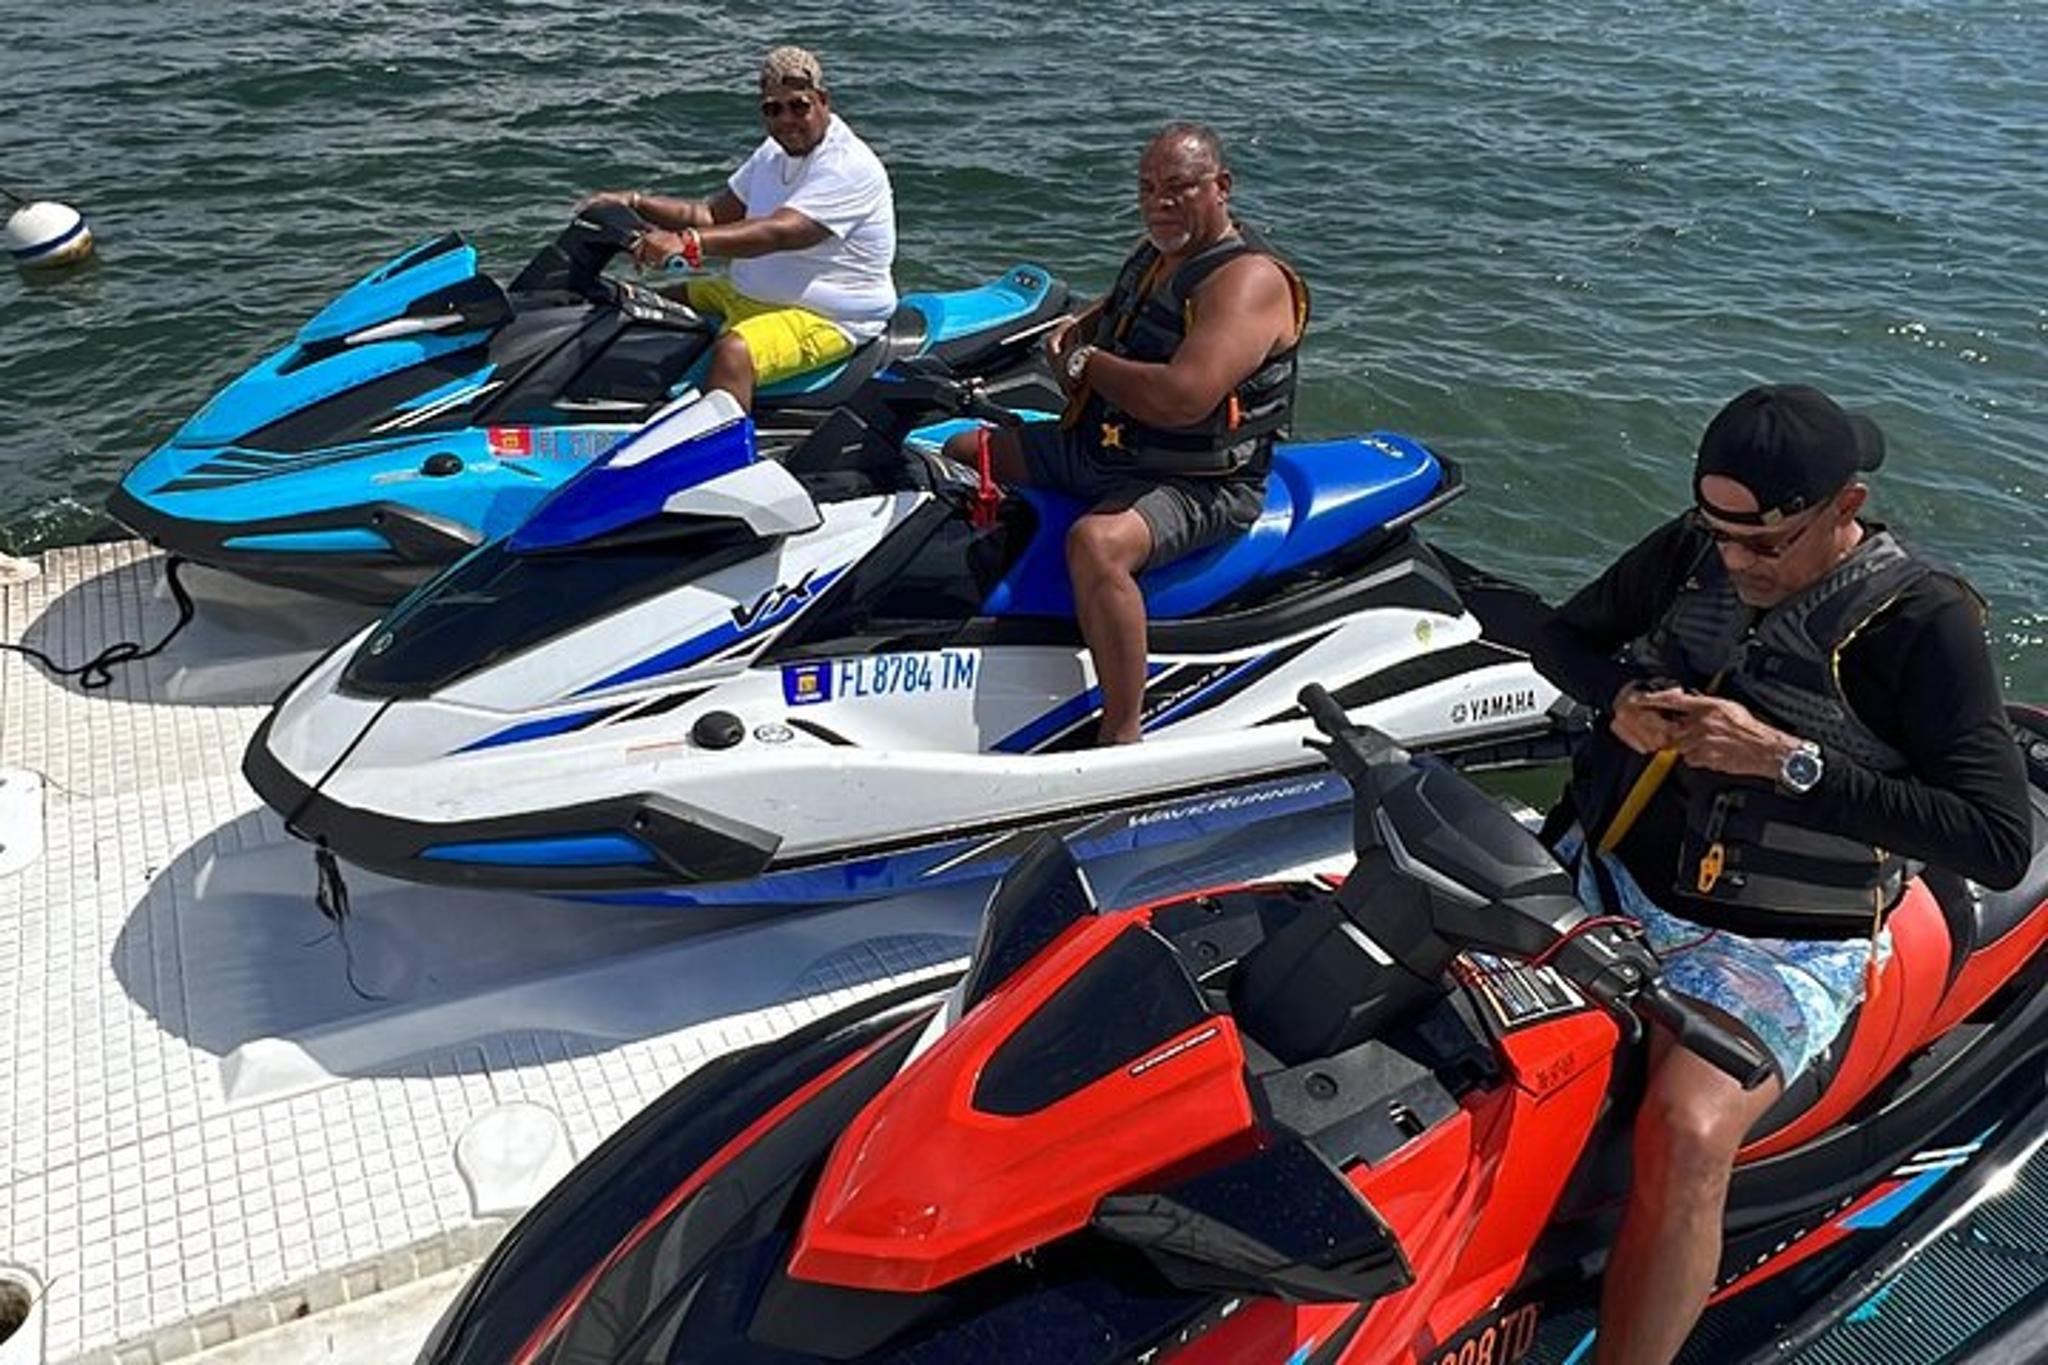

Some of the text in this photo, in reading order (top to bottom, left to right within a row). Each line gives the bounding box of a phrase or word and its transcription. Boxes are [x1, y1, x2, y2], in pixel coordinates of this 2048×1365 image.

[839, 651, 974, 697] FL 8784 TM
[1470, 689, 1536, 722] YAMAHA
